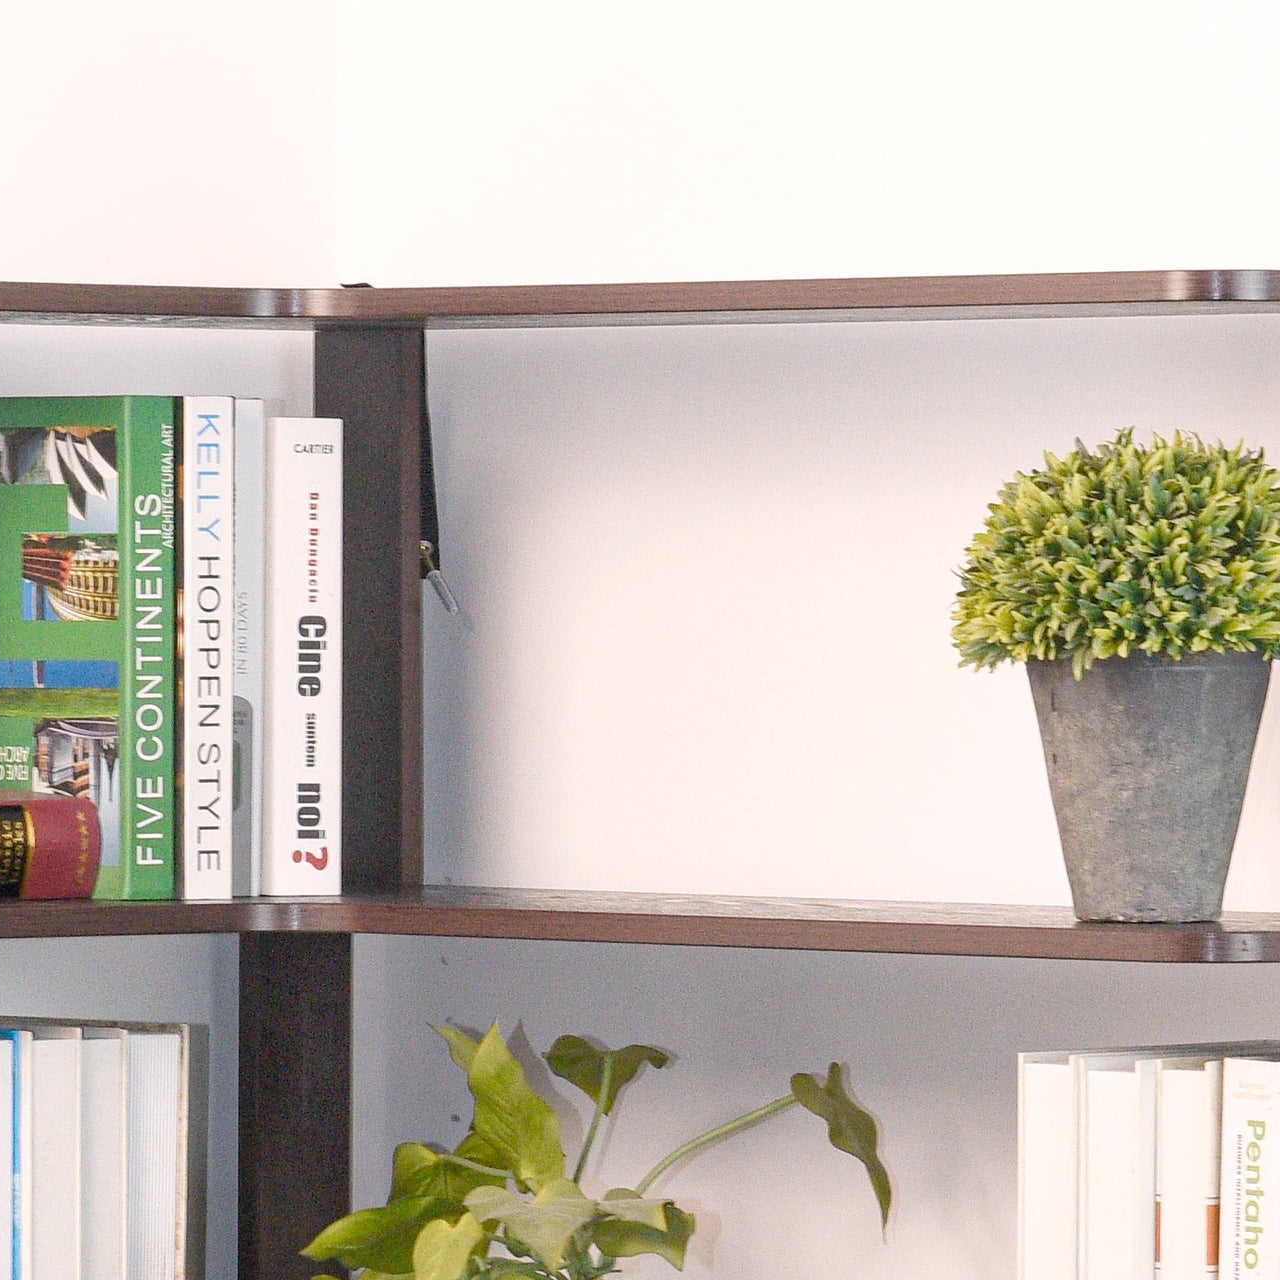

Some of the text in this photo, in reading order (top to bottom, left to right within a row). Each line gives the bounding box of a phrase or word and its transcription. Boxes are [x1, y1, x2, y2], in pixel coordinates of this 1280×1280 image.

[161, 423, 174, 549] ARCHITECTURAL ART
[293, 443, 334, 455] CARTIER
[134, 494, 164, 866] FIVE CONTINENTS
[196, 414, 221, 872] KELLY HOPPEN STYLE
[297, 615, 327, 697] Cine
[6, 764, 29, 780] FIVE
[1244, 1119, 1266, 1270] Pentaho
